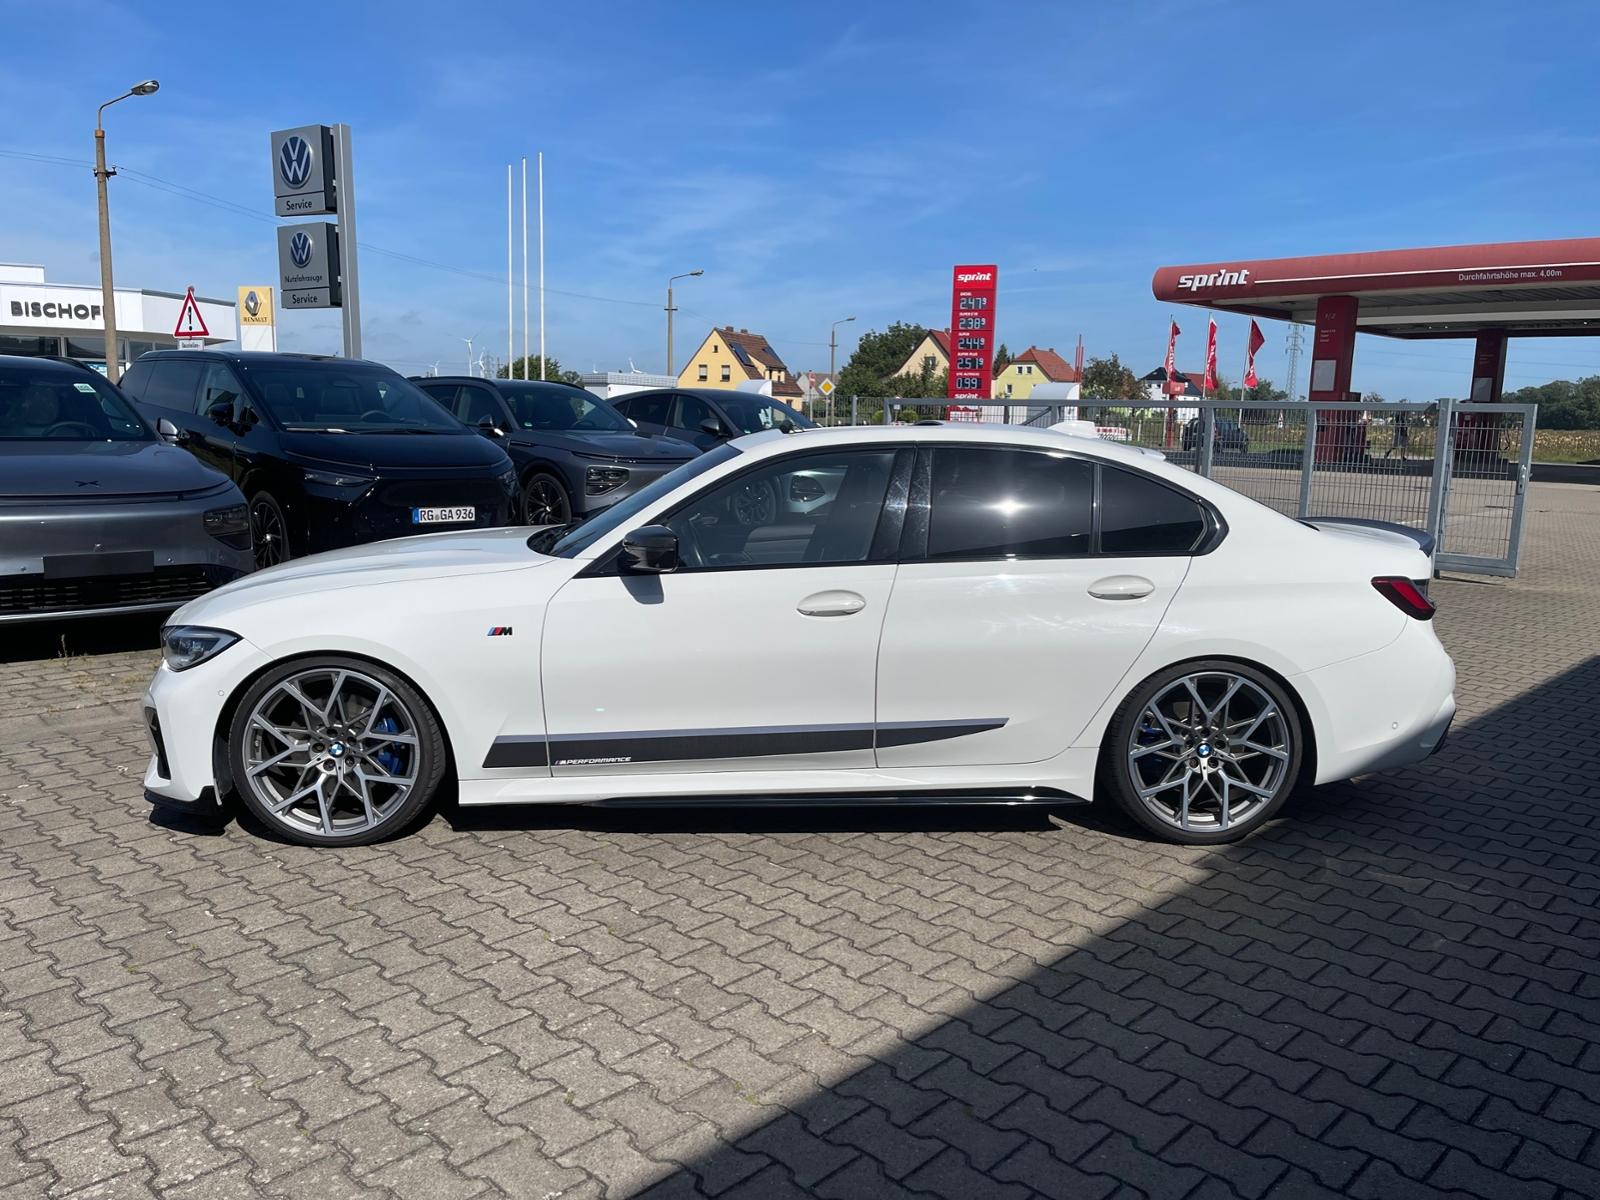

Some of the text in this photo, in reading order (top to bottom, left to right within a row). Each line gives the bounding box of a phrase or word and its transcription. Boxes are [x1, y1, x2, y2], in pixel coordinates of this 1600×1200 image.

[286, 200, 312, 210] Service
[957, 272, 992, 282] sprint
[1178, 269, 1250, 291] sprint
[1458, 271, 1518, 281] Durchfahrtshöhe
[292, 293, 318, 304] Service
[420, 508, 474, 520] RG GA 936
